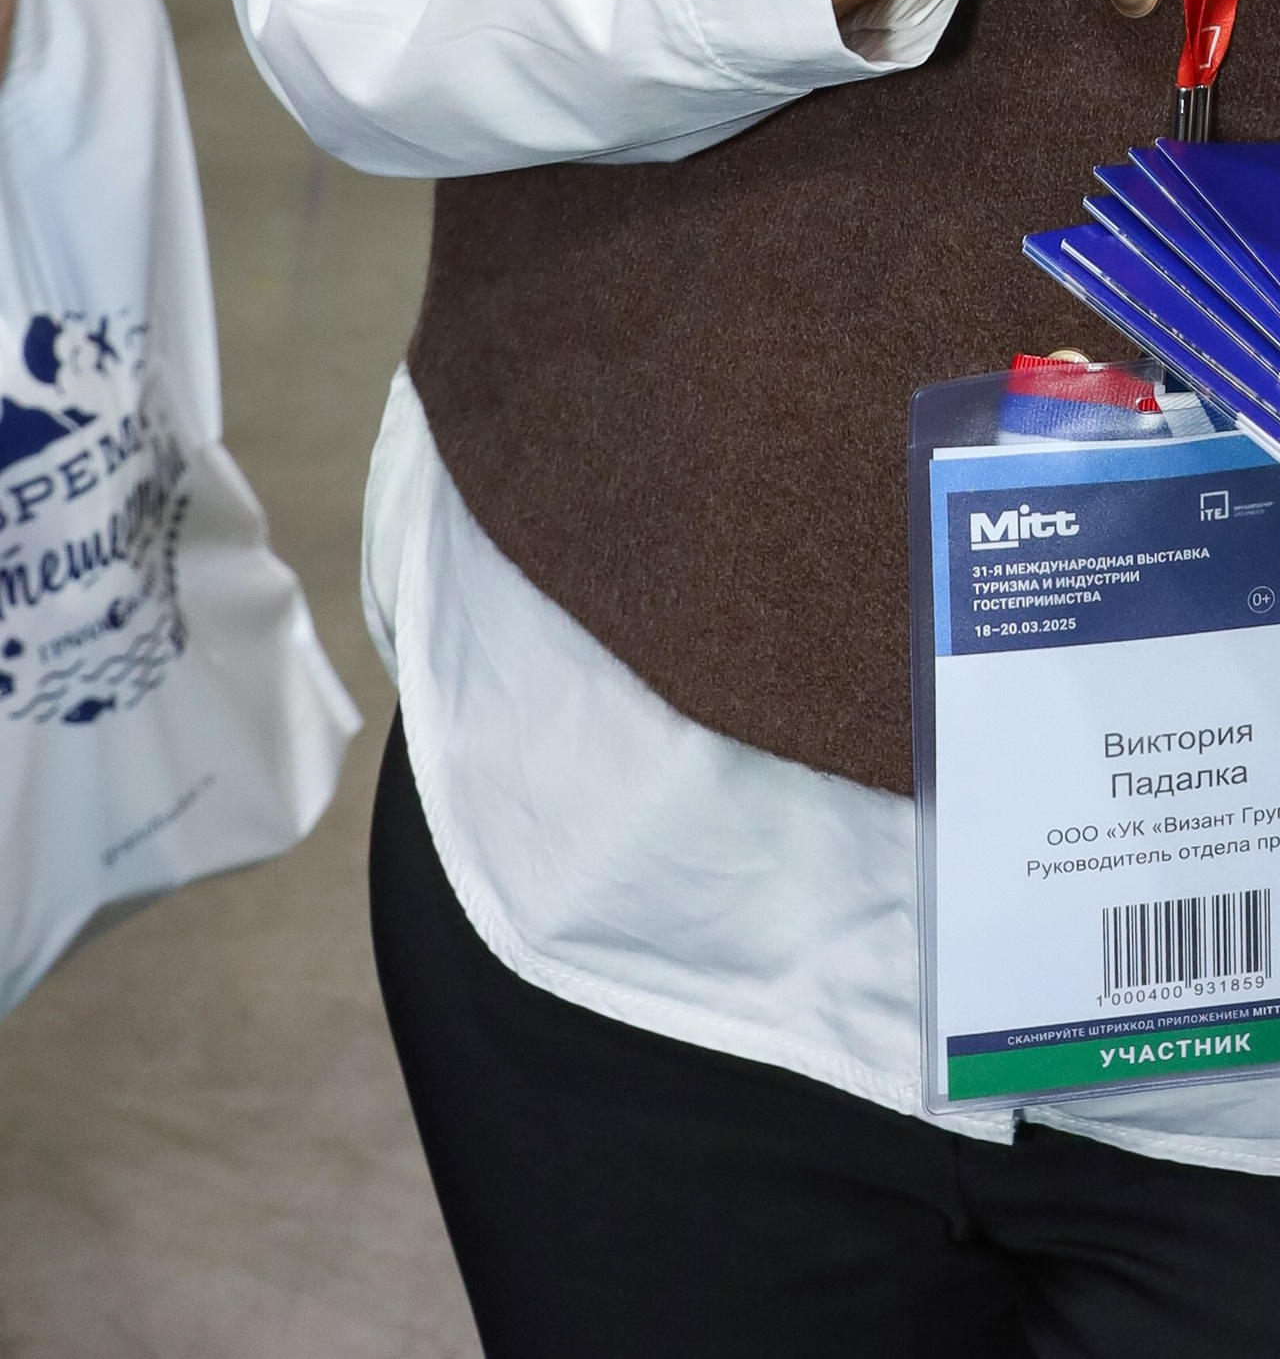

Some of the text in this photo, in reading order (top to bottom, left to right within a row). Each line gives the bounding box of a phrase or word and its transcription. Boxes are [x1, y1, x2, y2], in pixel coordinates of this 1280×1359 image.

[970, 503, 1080, 546] Mitt
[972, 547, 1210, 578] 31-Я МЕЖДУНАРОДНАЯ ВЫСТАВКА
[973, 571, 1140, 595] ТУРИЗМА И ИНДУСТРИИ
[973, 590, 1101, 611] ГОСТЕПРИИМСТВА
[1104, 724, 1253, 758] Виктория
[1111, 765, 1248, 798] Падалка
[1047, 825, 1098, 846] ООО
[1106, 820, 1145, 840] «УК
[1152, 811, 1235, 834] «Визант
[1027, 847, 1172, 878] Руководитель
[1179, 837, 1250, 859] отдела
[1111, 985, 1183, 1006] 000400
[1194, 975, 1265, 996] 931859
[1007, 1027, 1085, 1046] СКАНИРУЙТЕ
[1089, 1019, 1155, 1036] ШТРИХКОД
[1157, 1009, 1250, 1029] ПРИЛОЖЕНИЕМ
[1252, 1004, 1280, 1016] MITT
[1100, 1033, 1251, 1068] УЧАСТНИК
